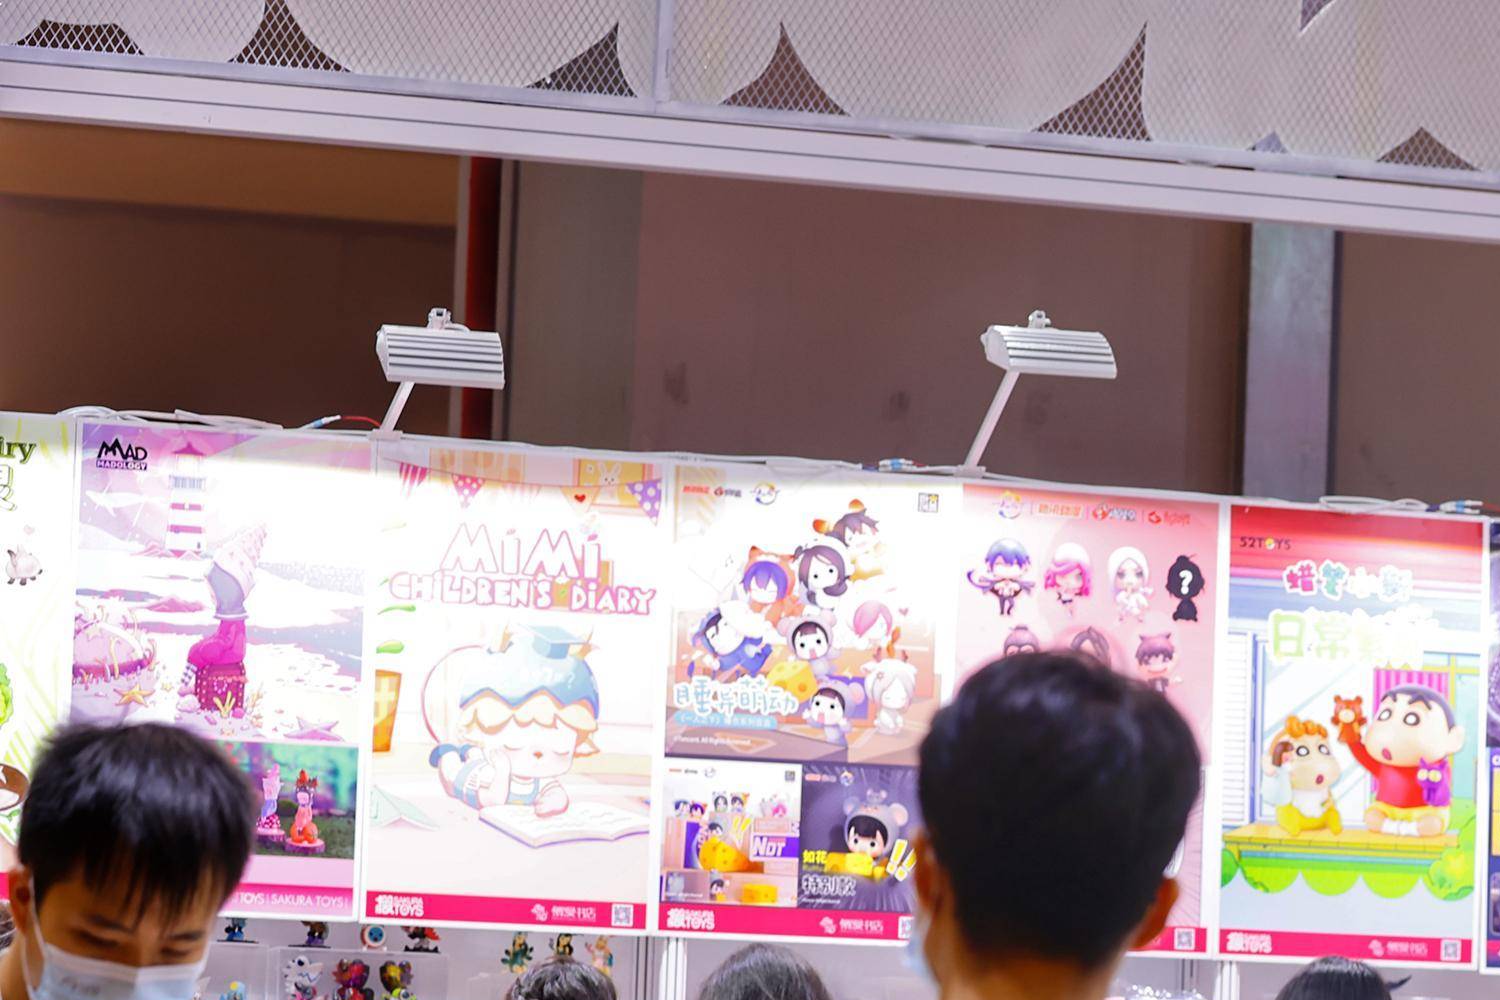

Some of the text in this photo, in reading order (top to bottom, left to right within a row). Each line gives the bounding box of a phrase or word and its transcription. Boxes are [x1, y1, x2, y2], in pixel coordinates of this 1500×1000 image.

[97, 437, 148, 462] MAD
[96, 460, 147, 471] MADOLOGY
[753, 836, 786, 857] NOT
[271, 893, 313, 909] SAKURA
[320, 895, 346, 910] TOYS
